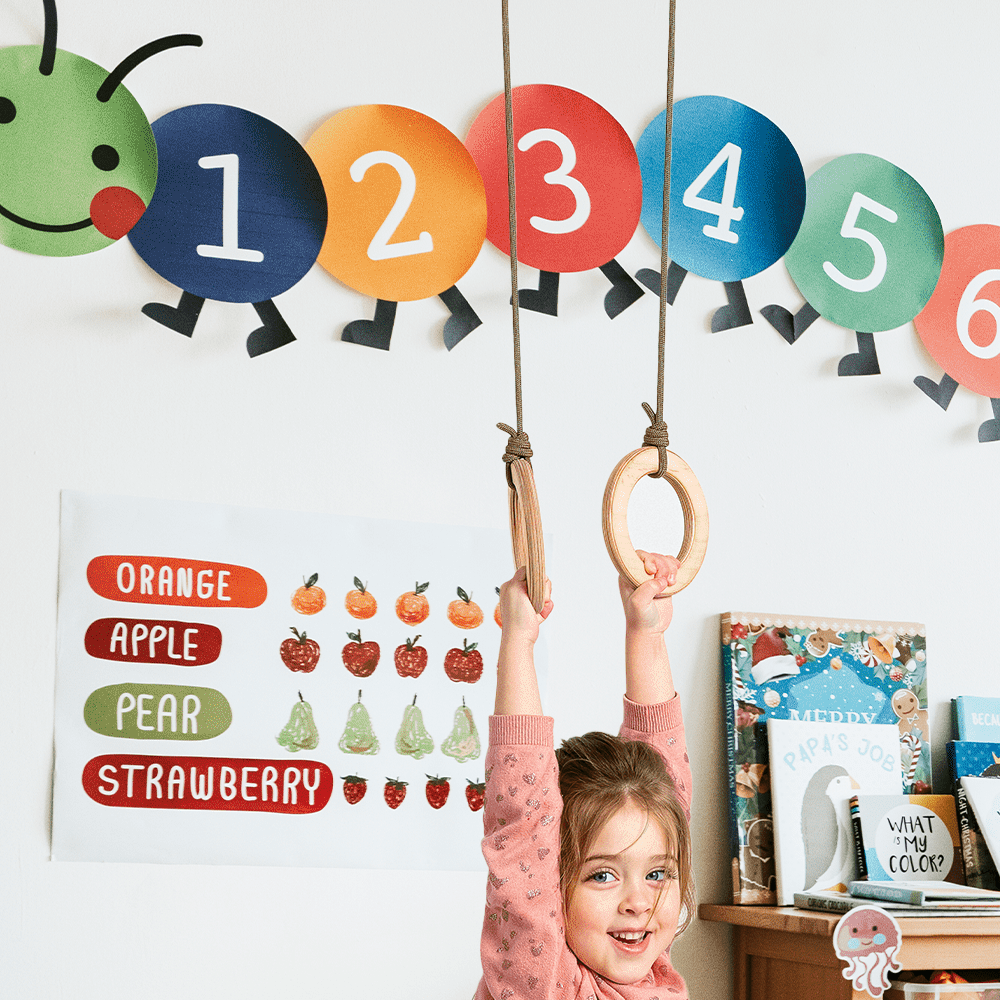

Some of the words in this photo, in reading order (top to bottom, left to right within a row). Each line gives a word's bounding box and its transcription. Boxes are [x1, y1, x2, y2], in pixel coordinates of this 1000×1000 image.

[197, 153, 264, 262] 1
[349, 150, 433, 261] 2
[517, 128, 591, 235] 3
[683, 142, 745, 245] 4
[822, 192, 899, 293] 5
[116, 562, 232, 602] ORANGE
[110, 622, 199, 661] APPLE
[115, 693, 201, 734] PEAR
[789, 708, 877, 725] MERRY
[783, 733, 849, 771] PAPA'S
[858, 738, 896, 772] JOB
[97, 764, 321, 806] STRAWBERRY
[887, 815, 935, 833] WHAT
[889, 854, 944, 873] COLOR?
